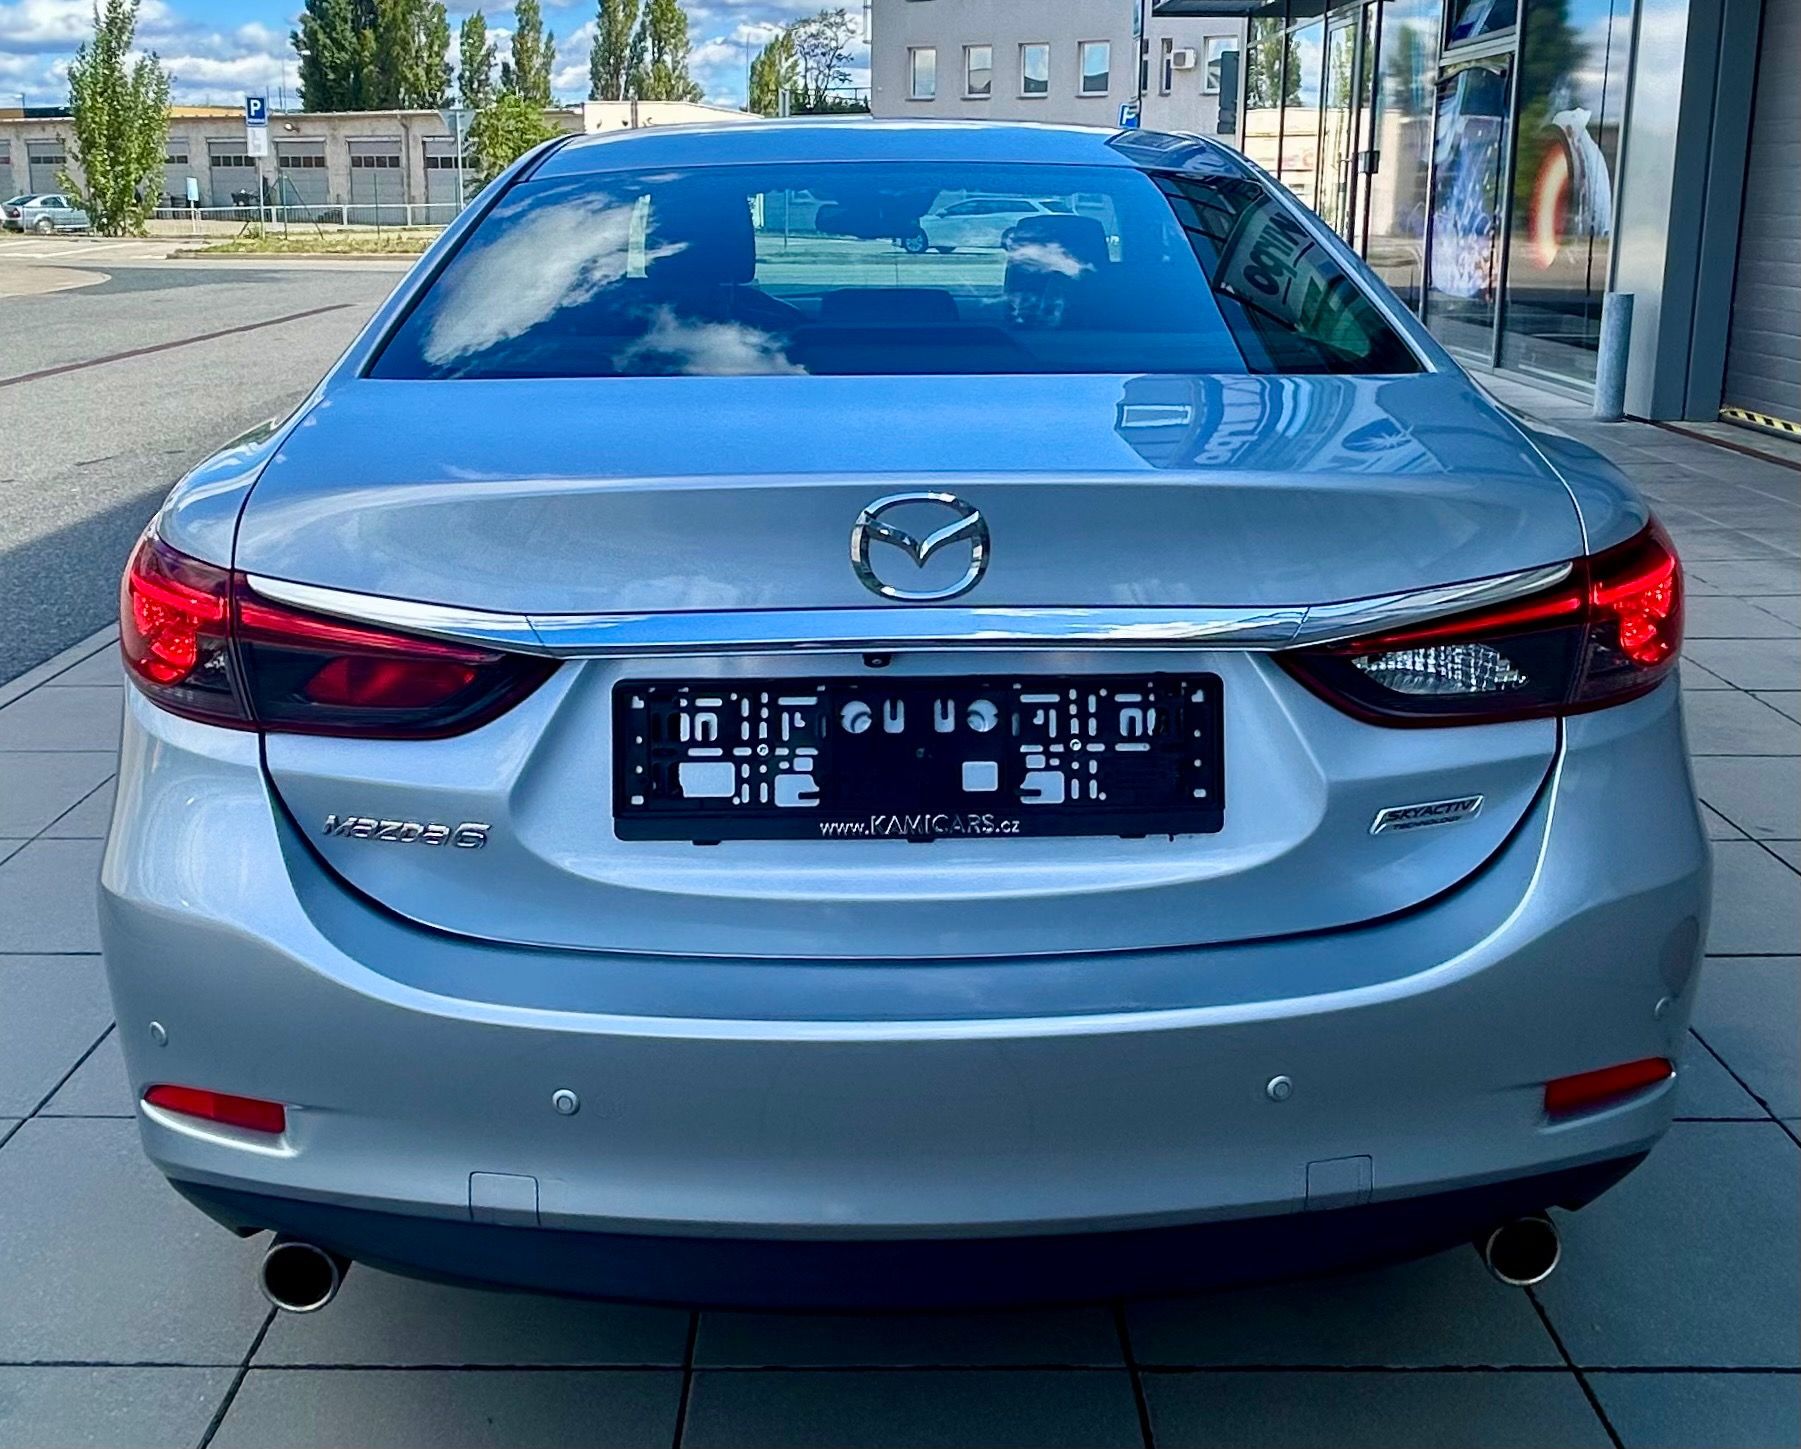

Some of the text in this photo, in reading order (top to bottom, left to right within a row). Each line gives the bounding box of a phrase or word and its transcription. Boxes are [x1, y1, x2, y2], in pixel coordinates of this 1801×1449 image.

[250, 99, 262, 117] P
[1386, 799, 1474, 821] SKYACTIV
[819, 813, 1021, 837] www.KAMICARS.cz
